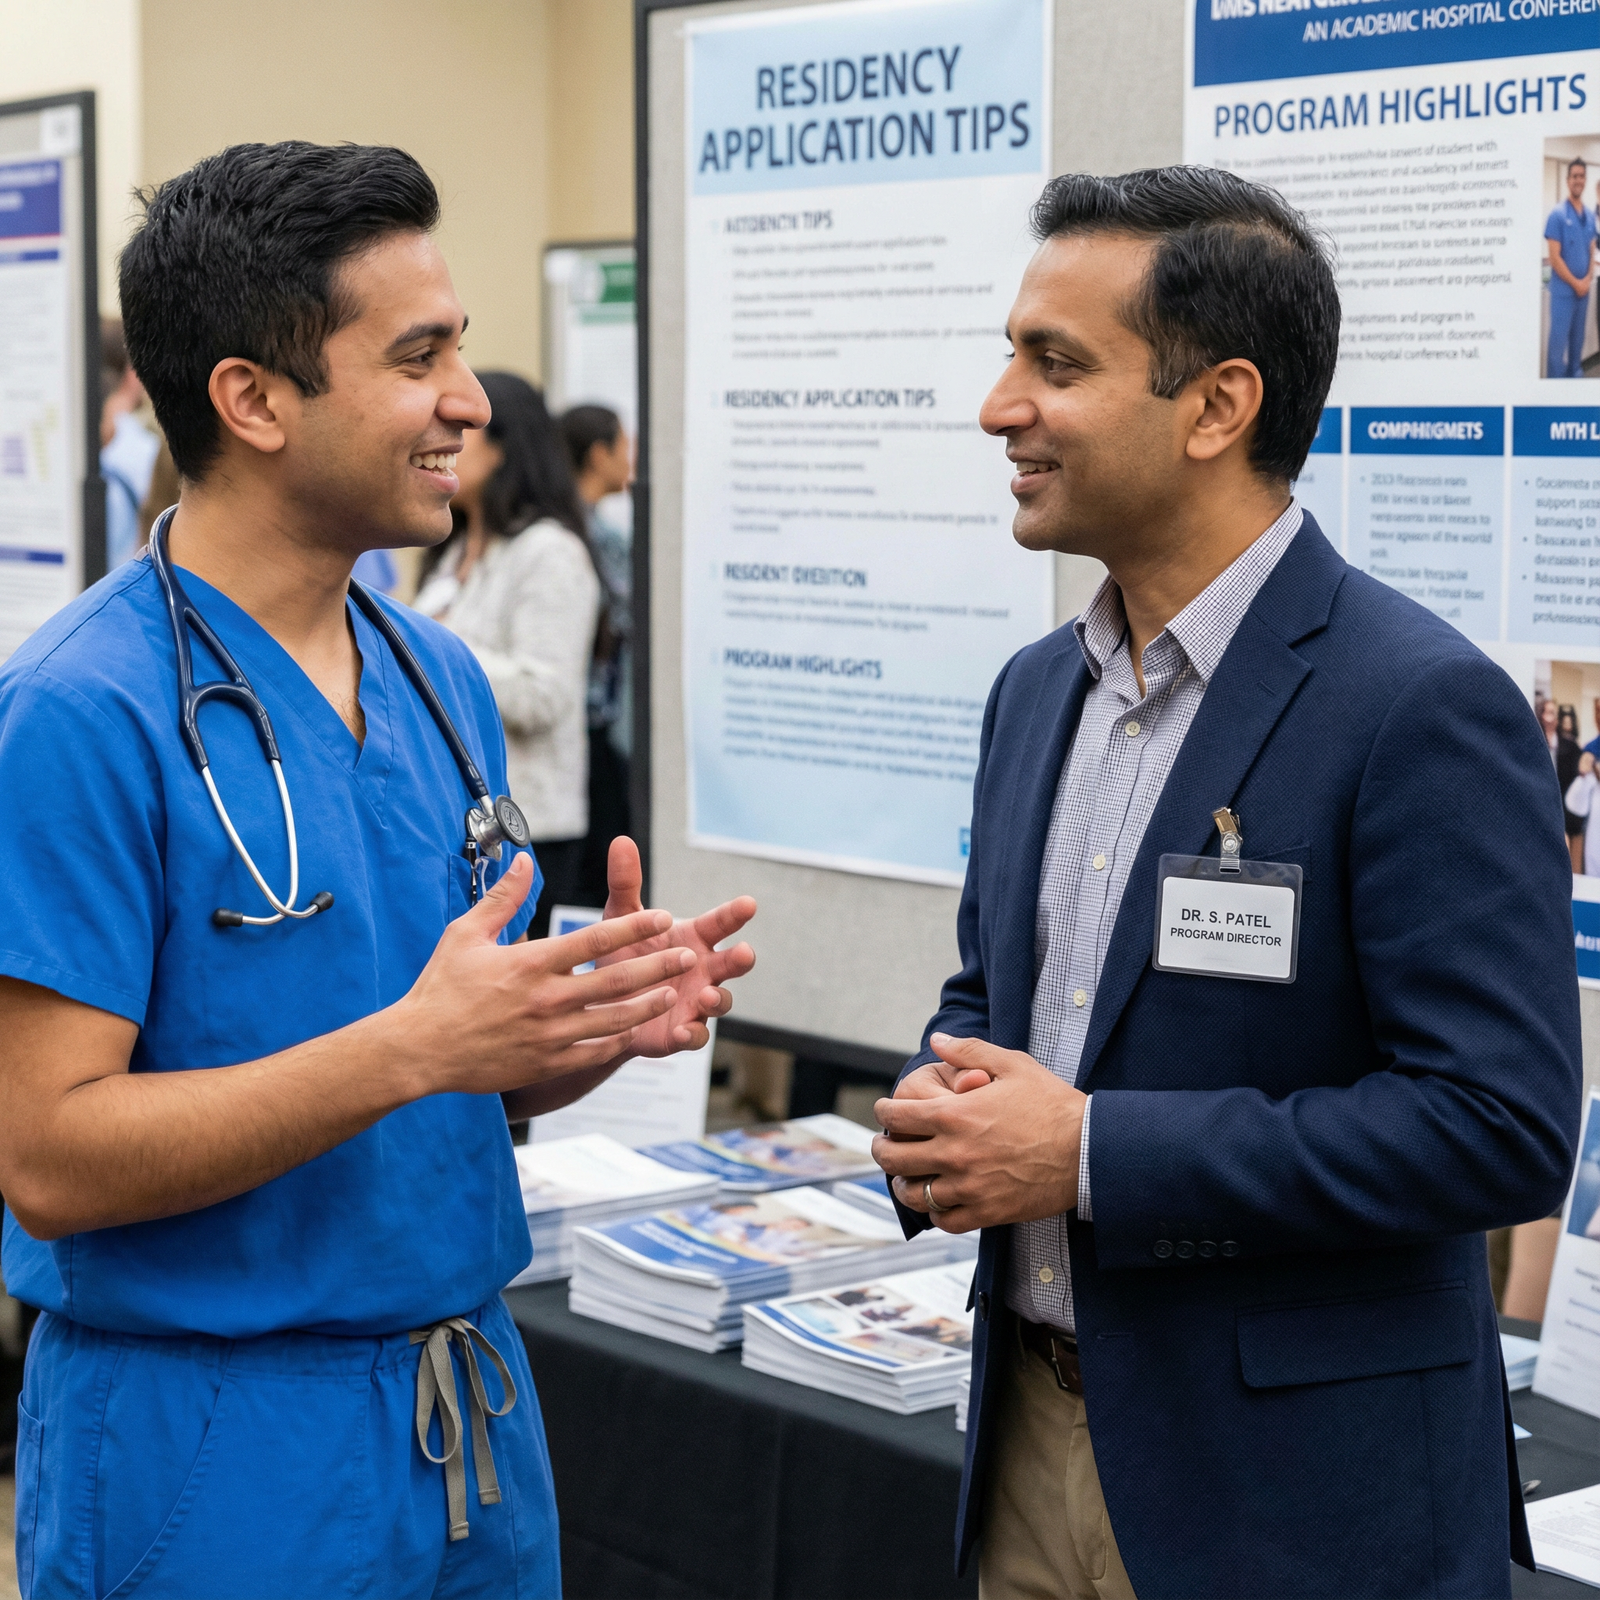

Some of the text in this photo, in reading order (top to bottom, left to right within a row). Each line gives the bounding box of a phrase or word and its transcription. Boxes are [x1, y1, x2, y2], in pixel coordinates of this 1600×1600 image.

[1302, 19, 1329, 42] AN
[1330, 9, 1420, 39] ACADEMIC
[1422, 1, 1506, 30] HOSPITAL
[756, 46, 961, 110] RESIDENCY
[1215, 73, 1587, 137] PROGRAM HIGHLIGHTS
[699, 101, 1030, 175] APPLICATION TIPS
[803, 389, 899, 408] APPLICATION
[904, 388, 936, 408] TIPS
[1550, 421, 1588, 440] MTH
[1181, 908, 1272, 929] DR. S. PATEL
[1170, 927, 1282, 947] PROGRAM DIRECTOR
